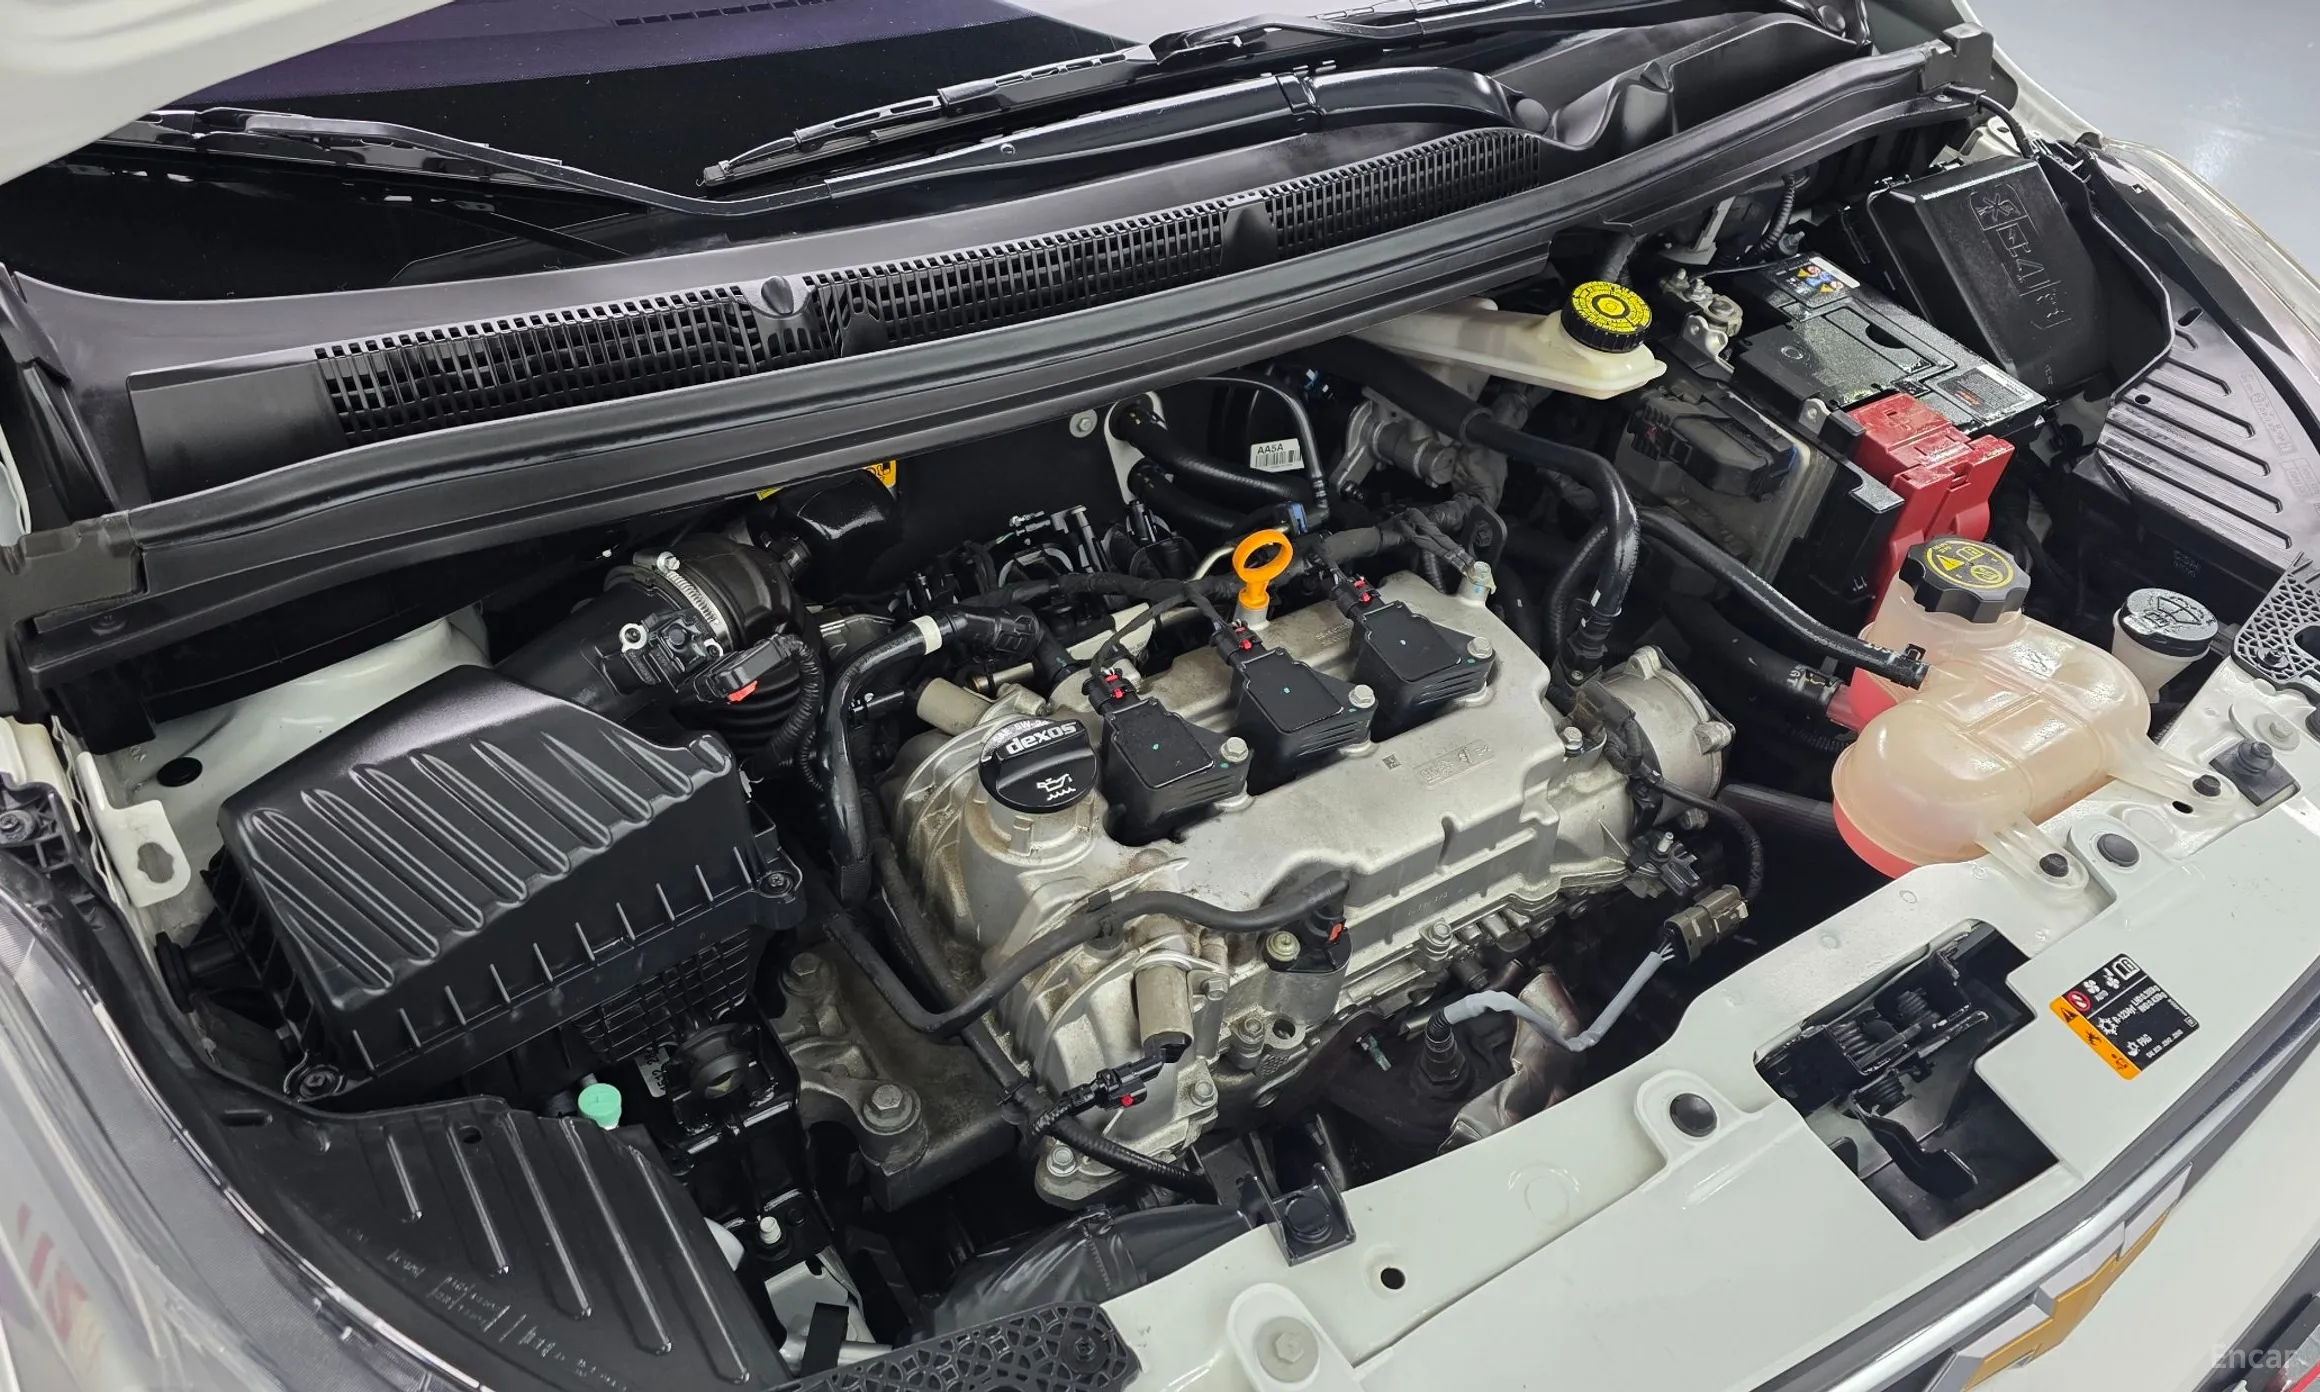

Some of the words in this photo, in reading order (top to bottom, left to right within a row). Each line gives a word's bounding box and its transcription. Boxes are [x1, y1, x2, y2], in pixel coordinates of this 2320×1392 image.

[1257, 443, 1284, 455] AA5A
[1005, 721, 1077, 755] dexos
[2136, 1033, 2153, 1047] PAG
